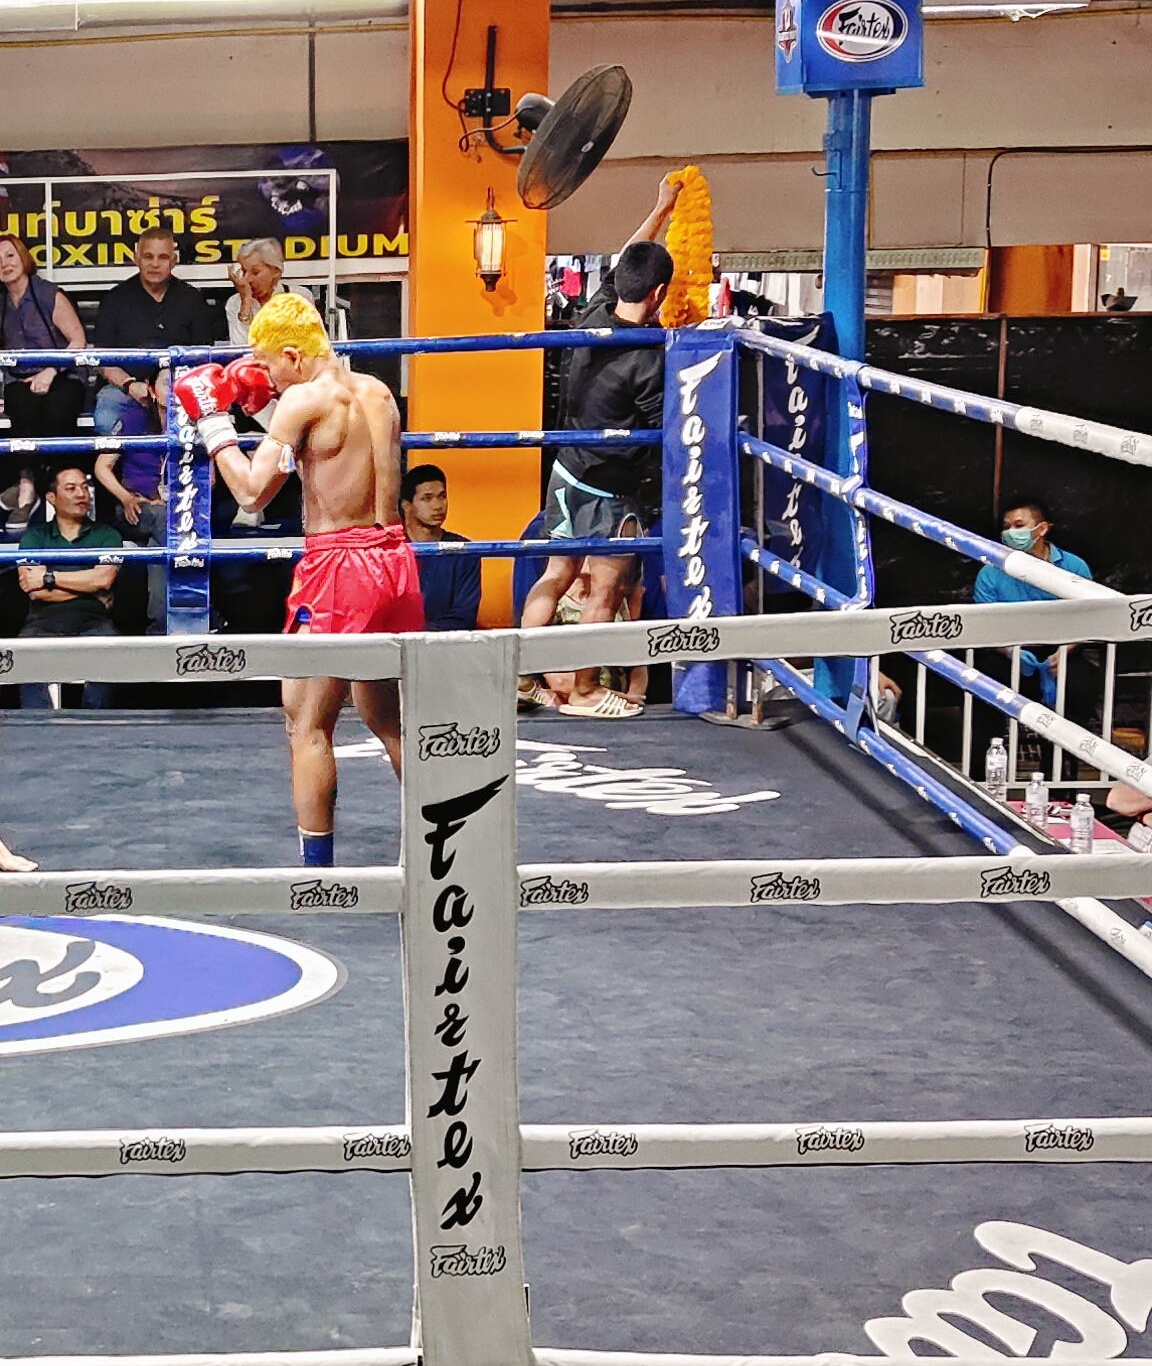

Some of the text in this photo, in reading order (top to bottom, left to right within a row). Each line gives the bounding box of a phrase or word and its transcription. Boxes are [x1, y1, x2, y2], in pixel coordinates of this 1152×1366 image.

[838, 6, 891, 47] Fairtex
[194, 232, 410, 263] STDIUM
[677, 351, 723, 619] Fairtex
[648, 625, 720, 656] Fairtex
[890, 610, 962, 642] Fairtex
[176, 644, 246, 674] Fairtex
[418, 722, 501, 761] Fairtex
[65, 881, 133, 912] Fairtex
[290, 879, 359, 910] Fairtex
[520, 876, 589, 908] Fairtex
[750, 871, 820, 902] Fairtex
[980, 866, 1050, 898] Fairtex
[420, 773, 510, 1231] Fairtex
[119, 1135, 186, 1164] Fairtex
[343, 1132, 411, 1161] Fairtex
[569, 1126, 638, 1157] Fairtex
[796, 1123, 865, 1153] Fairtex
[1023, 1122, 1095, 1153] Fairtex
[430, 1245, 507, 1277] Fairtex
